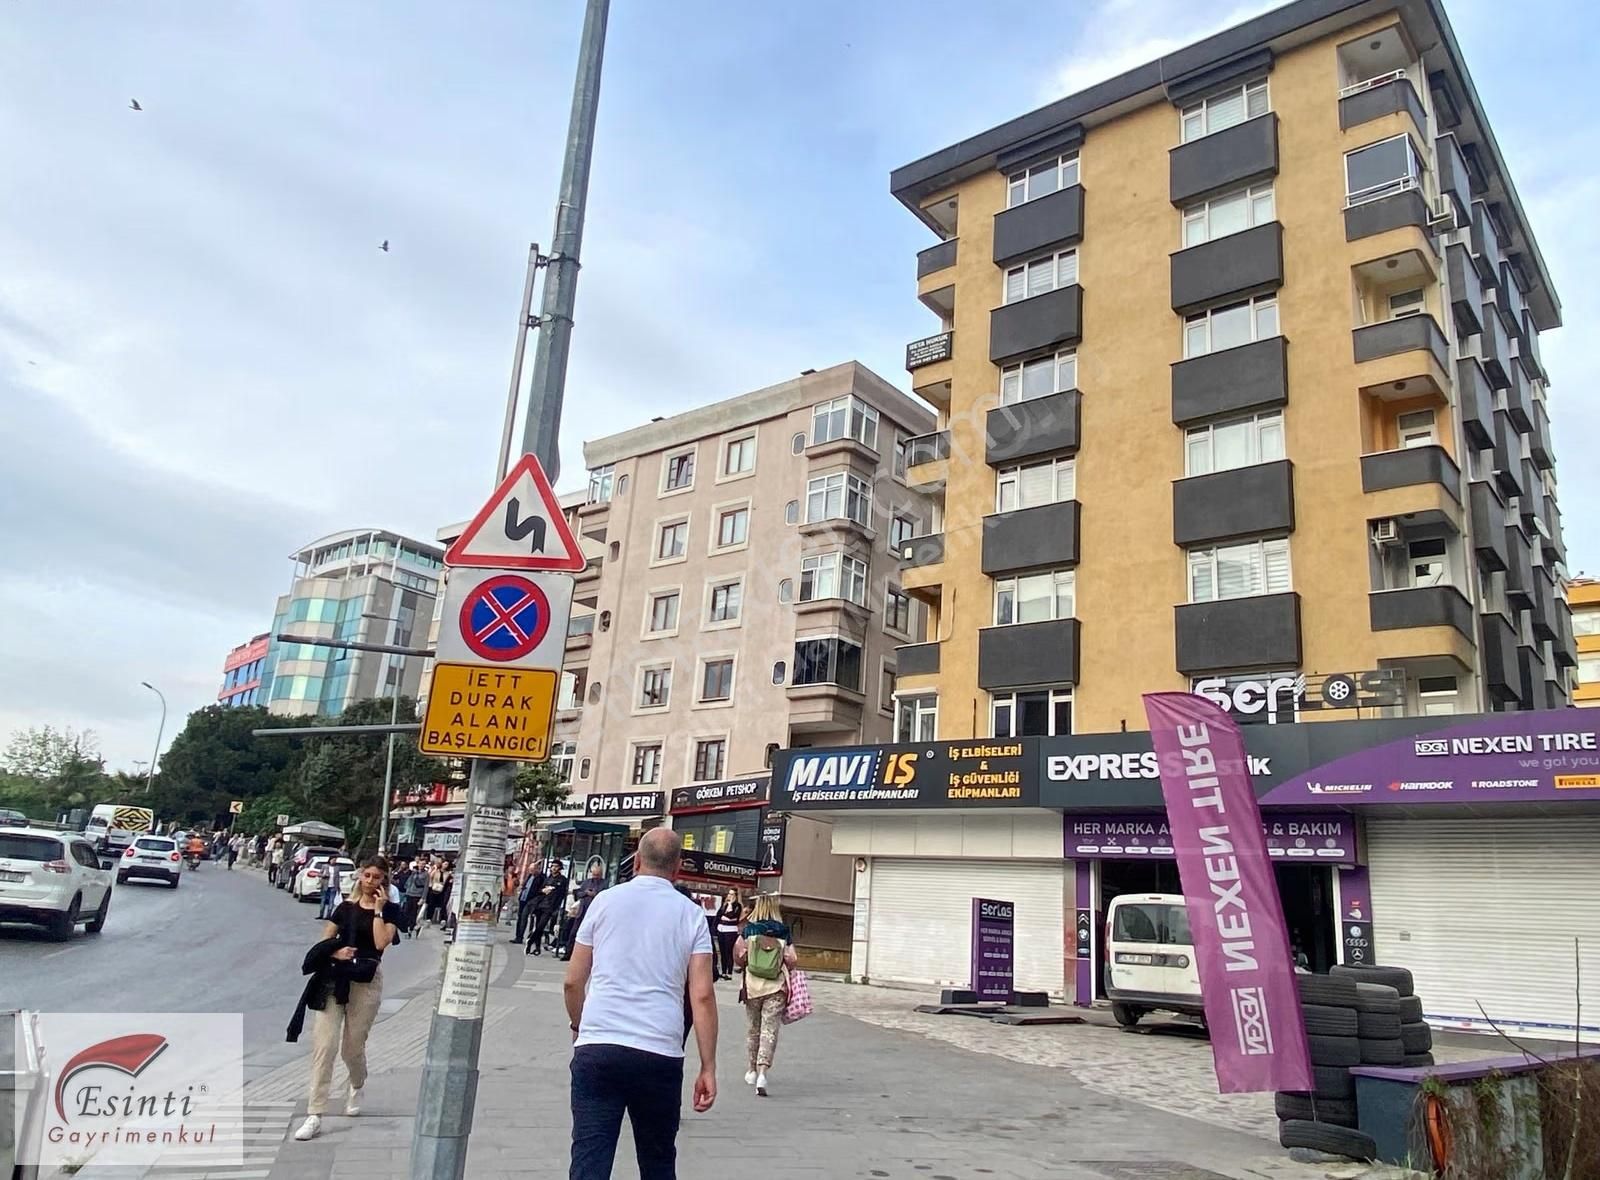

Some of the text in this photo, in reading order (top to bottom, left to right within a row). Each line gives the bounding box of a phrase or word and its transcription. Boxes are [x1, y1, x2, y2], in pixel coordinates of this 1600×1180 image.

[468, 668, 522, 689] İETT
[450, 692, 533, 710] DURAK
[451, 713, 527, 731] ALANI
[428, 731, 543, 753] BAŞLANGICI
[1452, 735, 1533, 755] NEXEN
[1538, 732, 1597, 752] TIRE
[949, 743, 1022, 760] İŞ ELBİSELERİ
[980, 761, 988, 770] &
[1518, 758, 1540, 769] we
[1543, 755, 1567, 770] got
[950, 771, 1019, 787] İŞ GÜVENLİĞİ
[1479, 779, 1539, 788] ROADSTONE
[696, 783, 757, 799] GÖRKEM PETSHOP
[793, 791, 802, 802] İŞ
[802, 789, 849, 801] ELBİSELERİ
[857, 787, 919, 800] EKİPMANLARI
[948, 786, 1020, 798] EKİPMANLARI
[589, 792, 656, 814] ÇİFA DERİ
[1074, 823, 1100, 835] HER
[1105, 823, 1155, 835] MARKA
[1273, 823, 1283, 835] &
[1288, 823, 1342, 836] BAKIM
[704, 861, 757, 876] GÖRKEM PETSHOP
